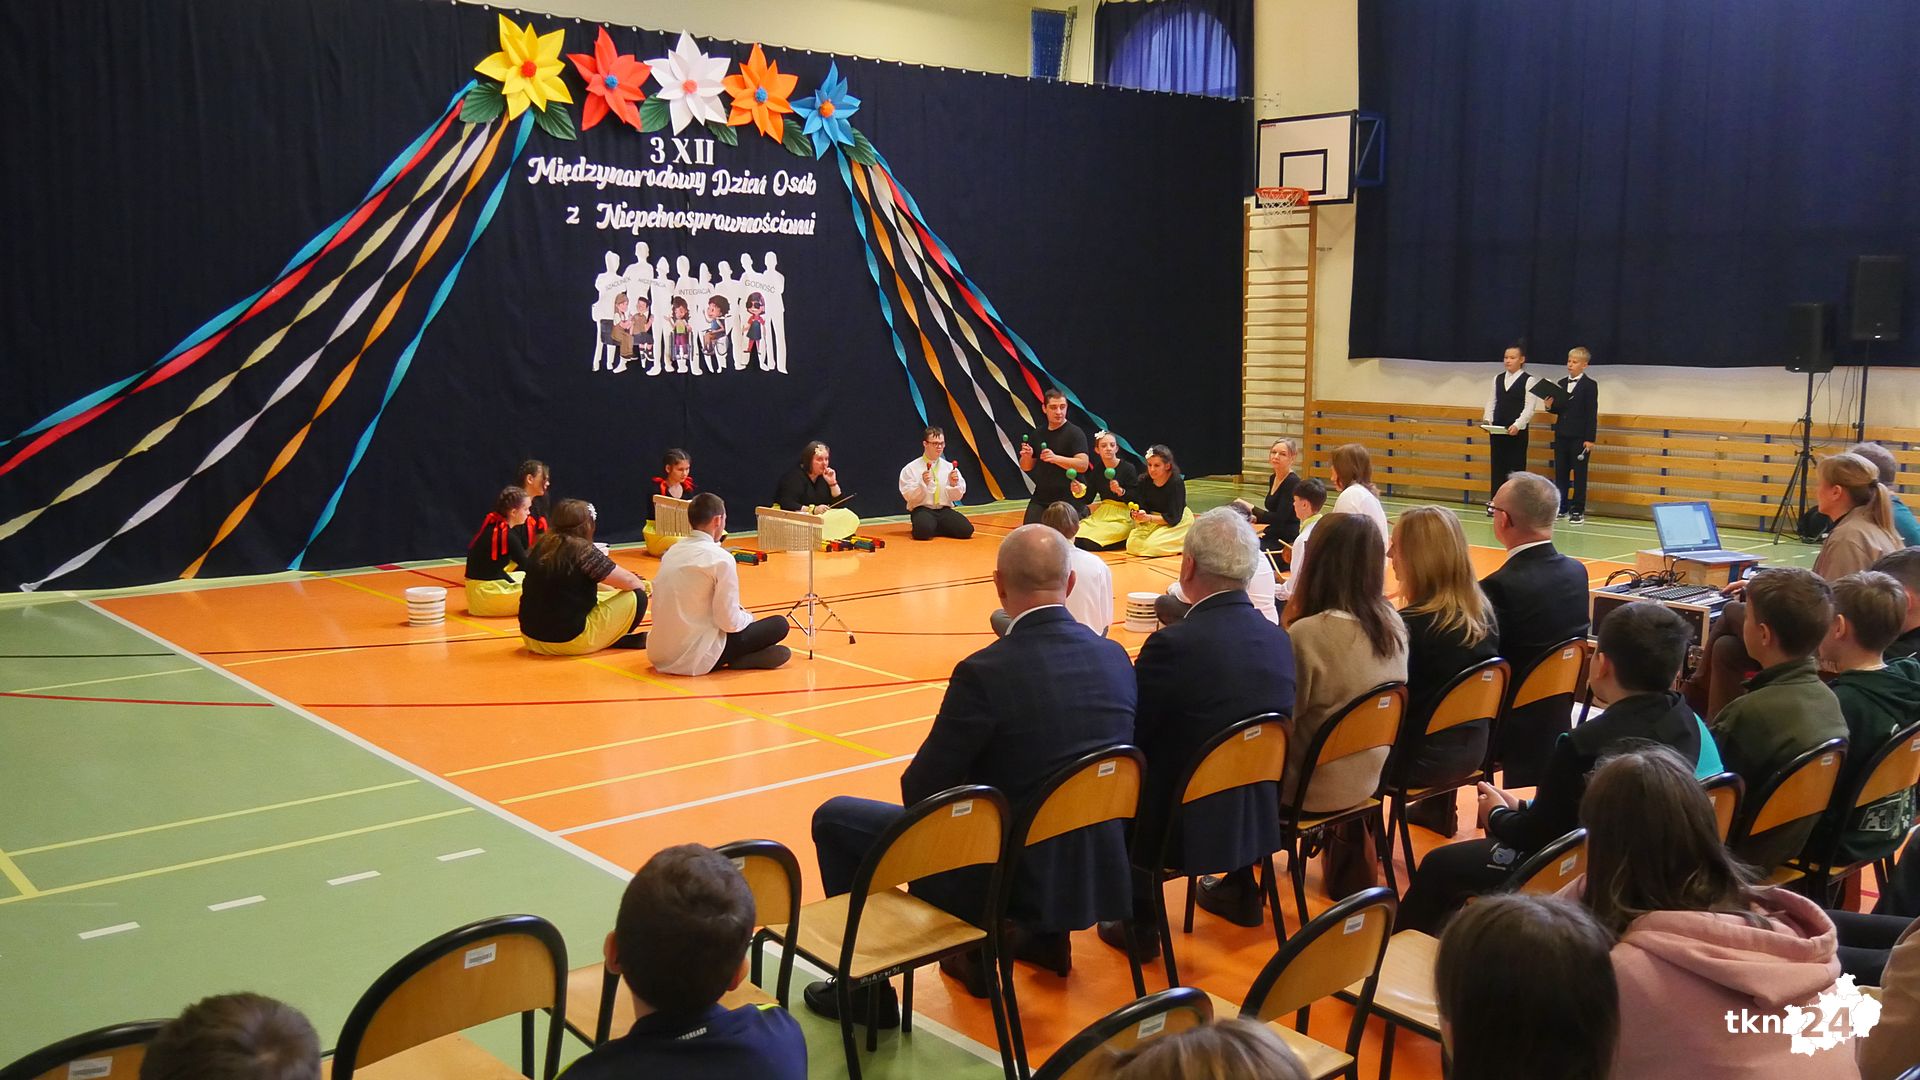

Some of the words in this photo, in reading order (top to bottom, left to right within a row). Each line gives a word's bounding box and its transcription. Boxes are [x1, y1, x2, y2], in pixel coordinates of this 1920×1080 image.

[650, 137, 666, 164] 3
[671, 138, 715, 166] XII
[528, 156, 707, 197] Międzynarodowy
[712, 169, 768, 197] Dzień
[773, 169, 817, 197] Osób
[596, 201, 817, 236] Niepełnosprawnościami
